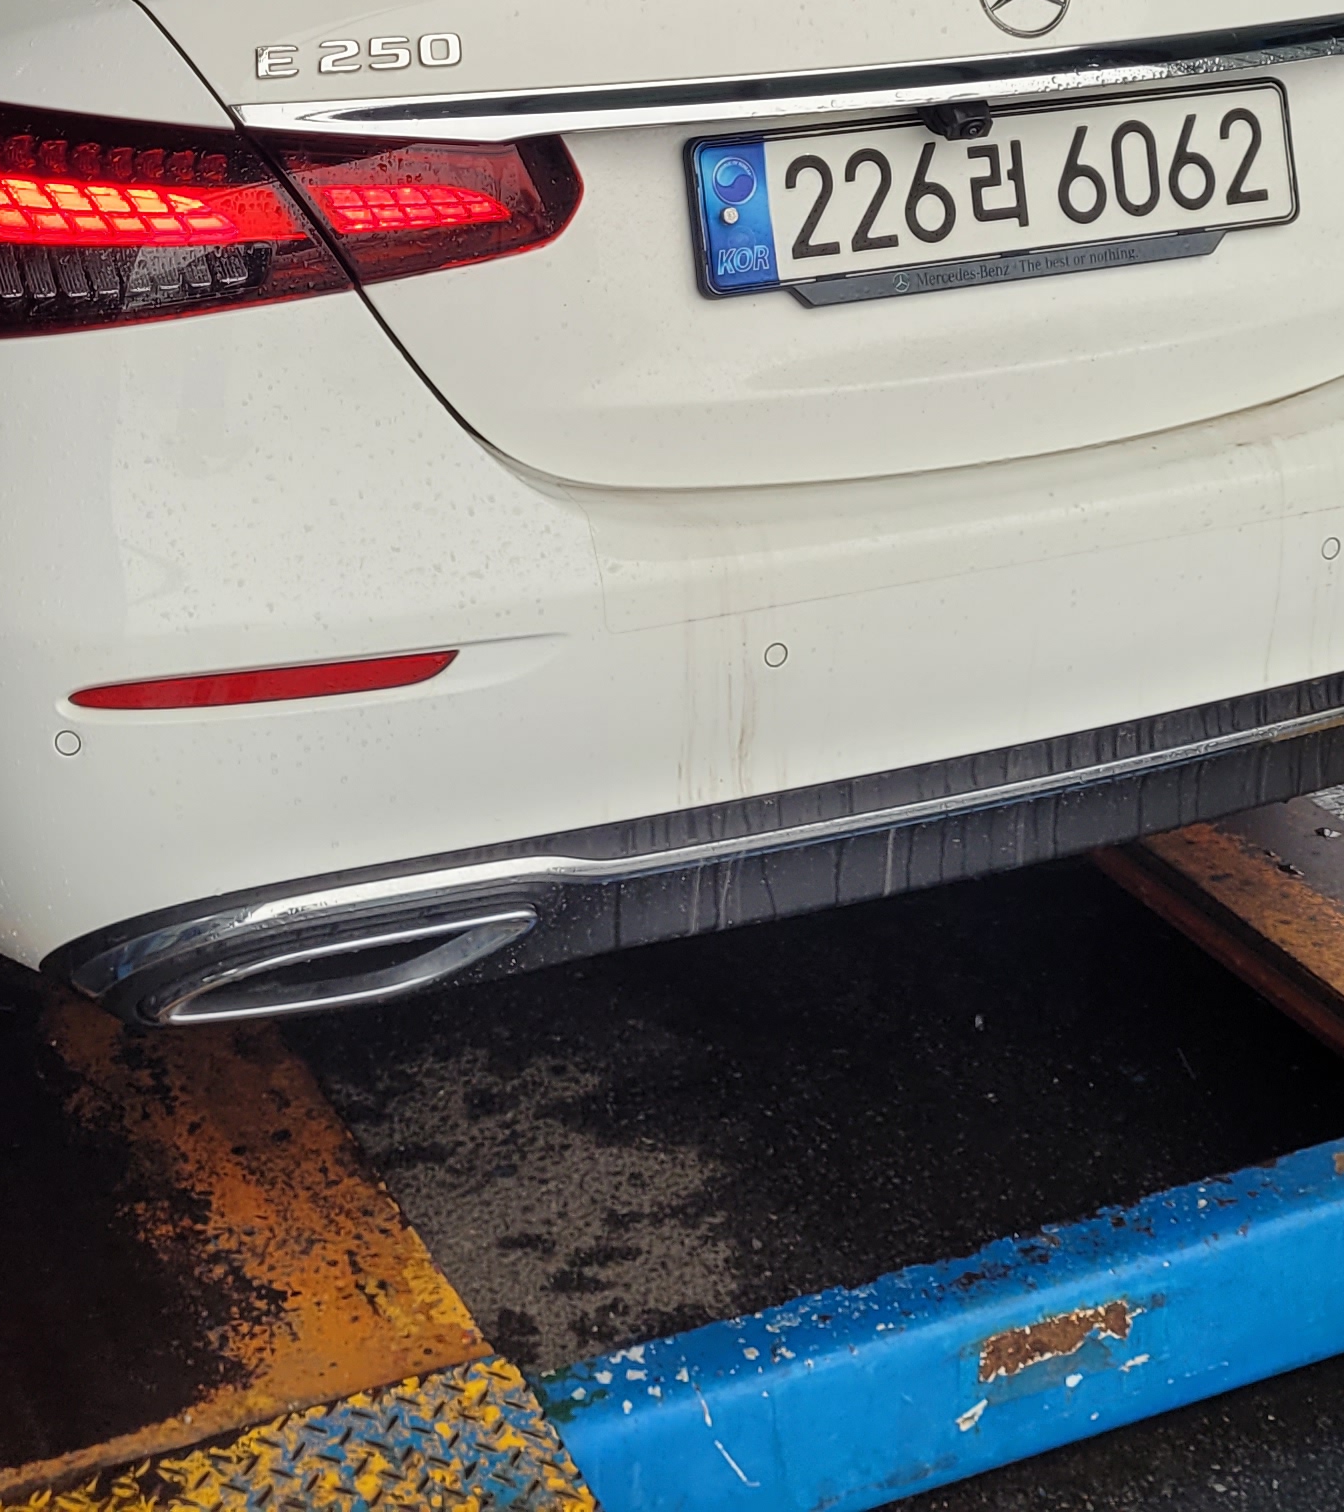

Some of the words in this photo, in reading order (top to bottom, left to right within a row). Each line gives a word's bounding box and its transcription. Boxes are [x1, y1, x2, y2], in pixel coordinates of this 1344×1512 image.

[256, 44, 300, 79] E
[318, 32, 462, 74] 250
[784, 139, 1029, 260] 226러
[1057, 107, 1269, 225] 6062
[718, 245, 770, 275] KOR
[917, 262, 1010, 287] Mercedes-Benz
[1019, 258, 1042, 273] The
[1045, 254, 1069, 268] best
[1074, 255, 1086, 266] or
